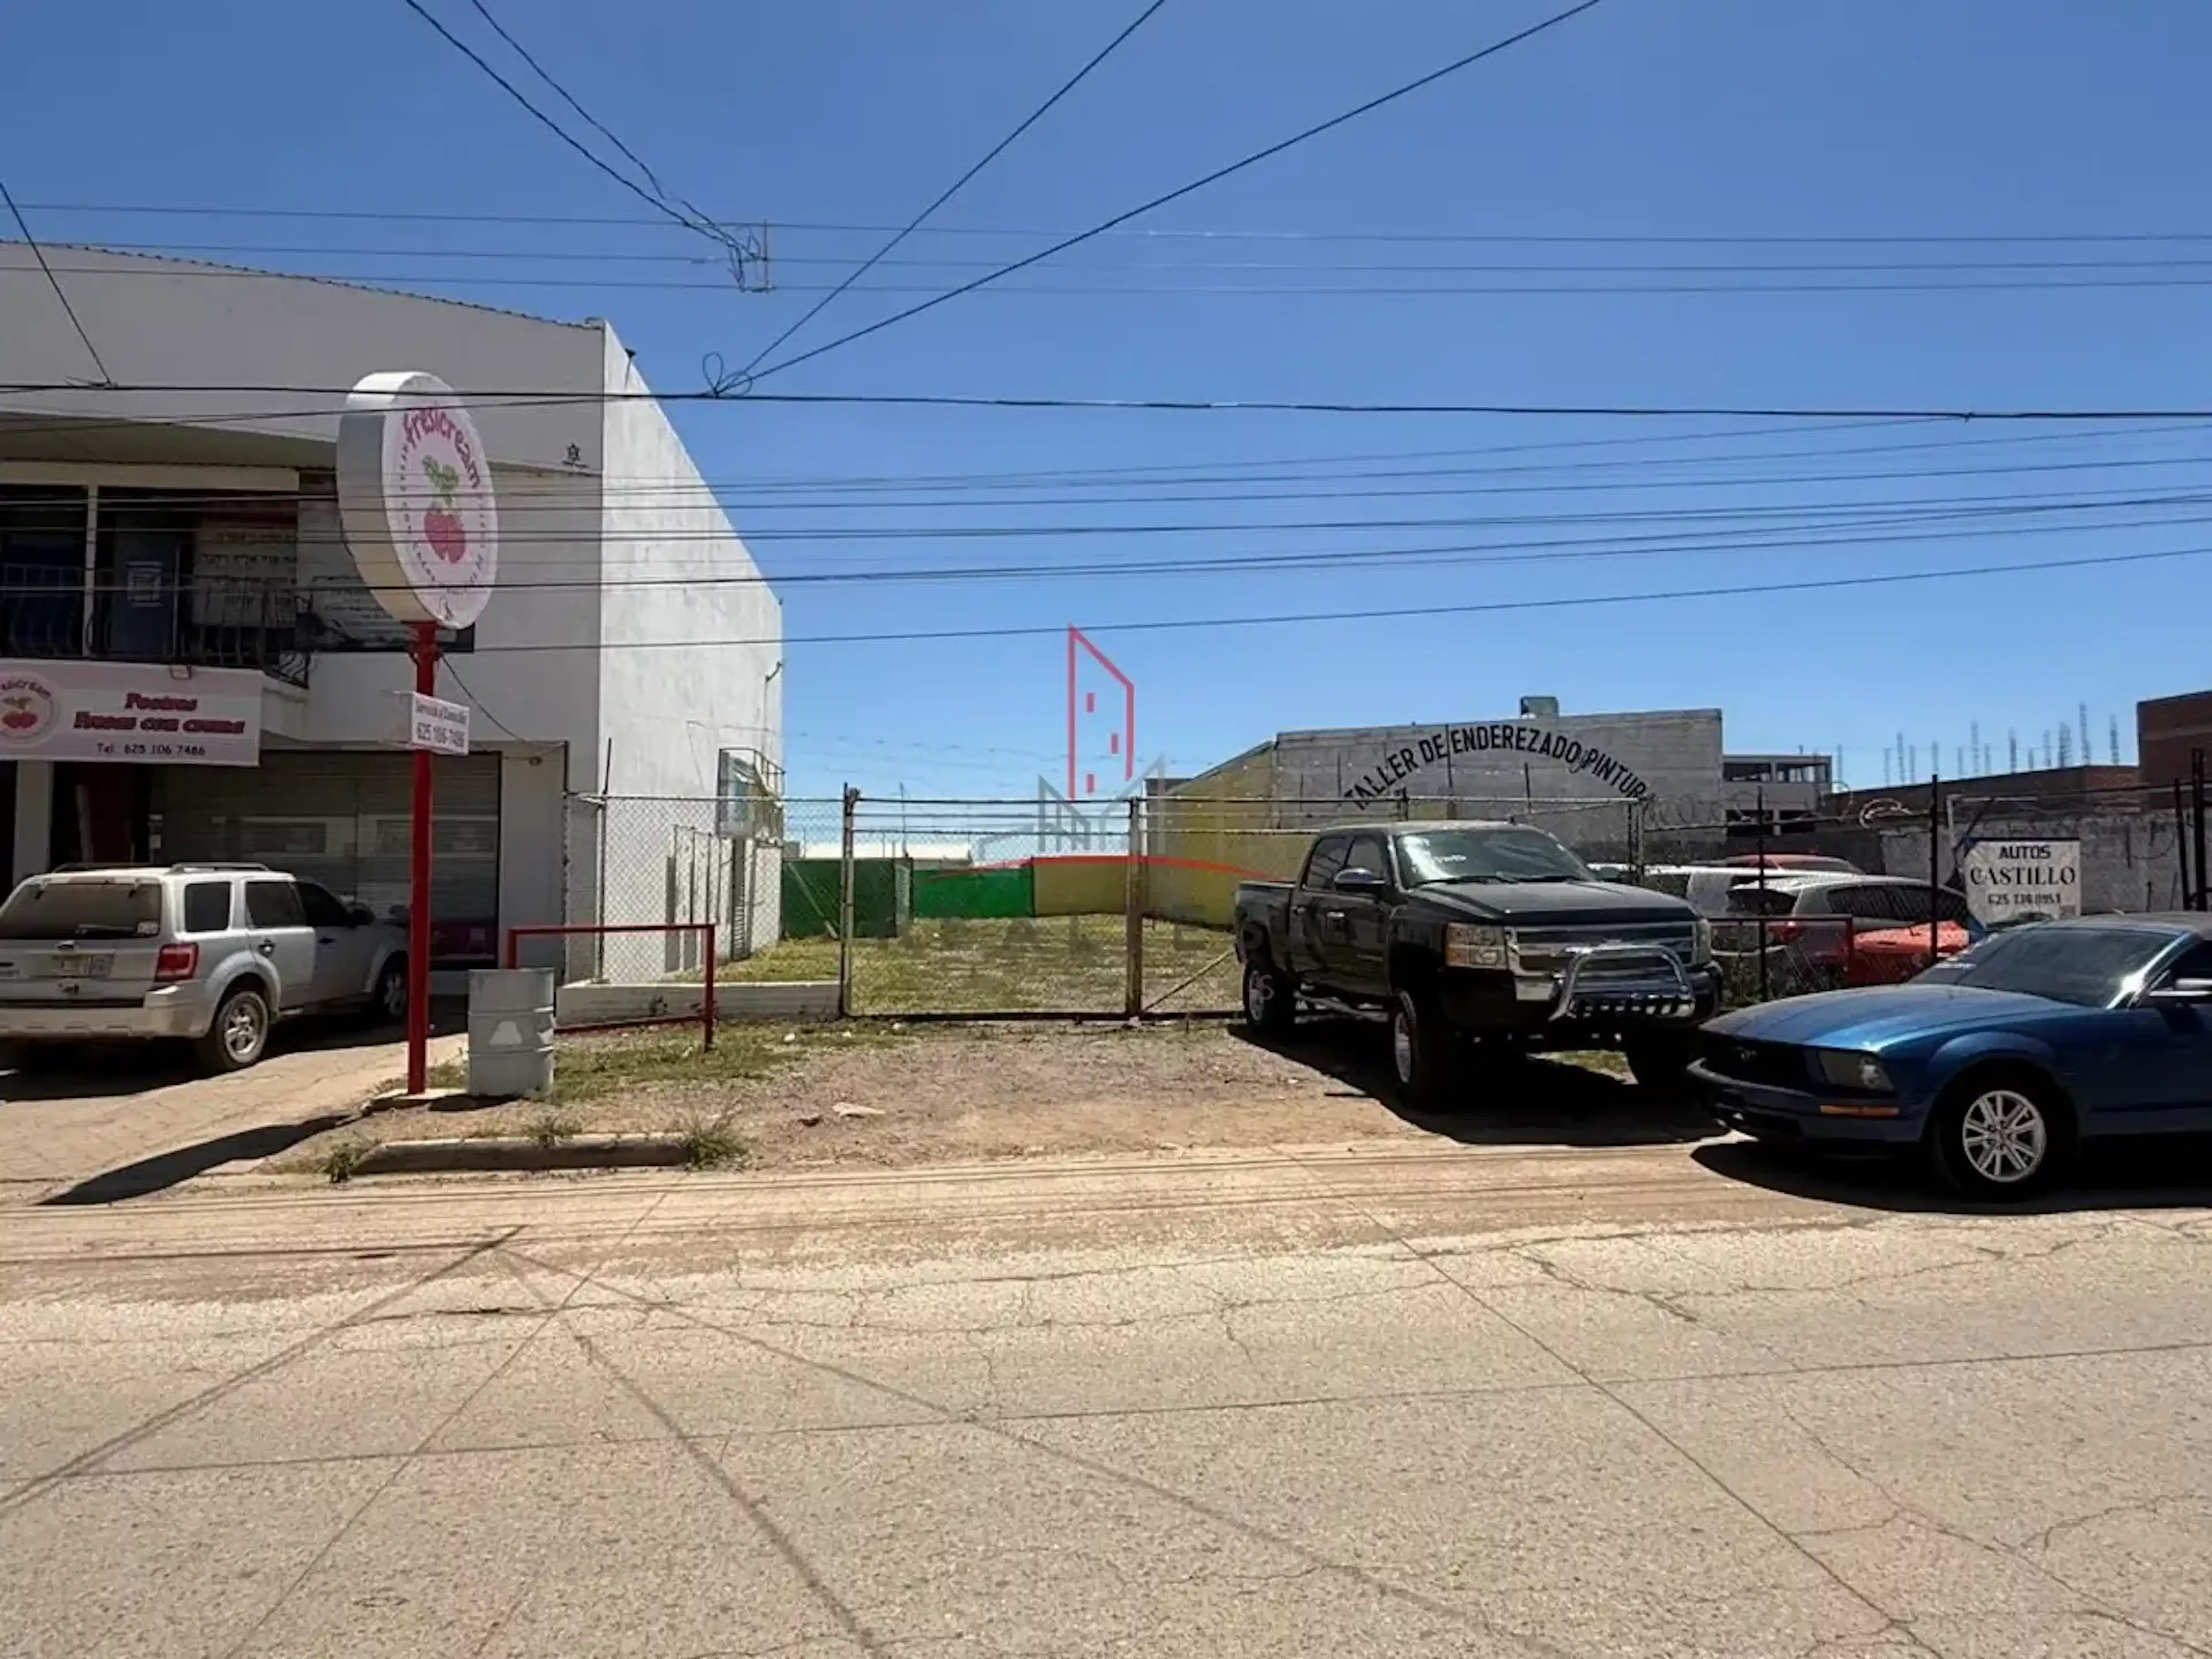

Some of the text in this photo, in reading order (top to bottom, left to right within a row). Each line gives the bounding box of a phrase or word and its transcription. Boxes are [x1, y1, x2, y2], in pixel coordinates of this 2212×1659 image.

[1344, 748, 1419, 810] TALLER
[1418, 733, 1449, 762] DE
[1450, 724, 1581, 764] ENDEREZADO
[1998, 845, 2052, 859] AUTOS
[1970, 865, 2076, 885] CASTILLO
